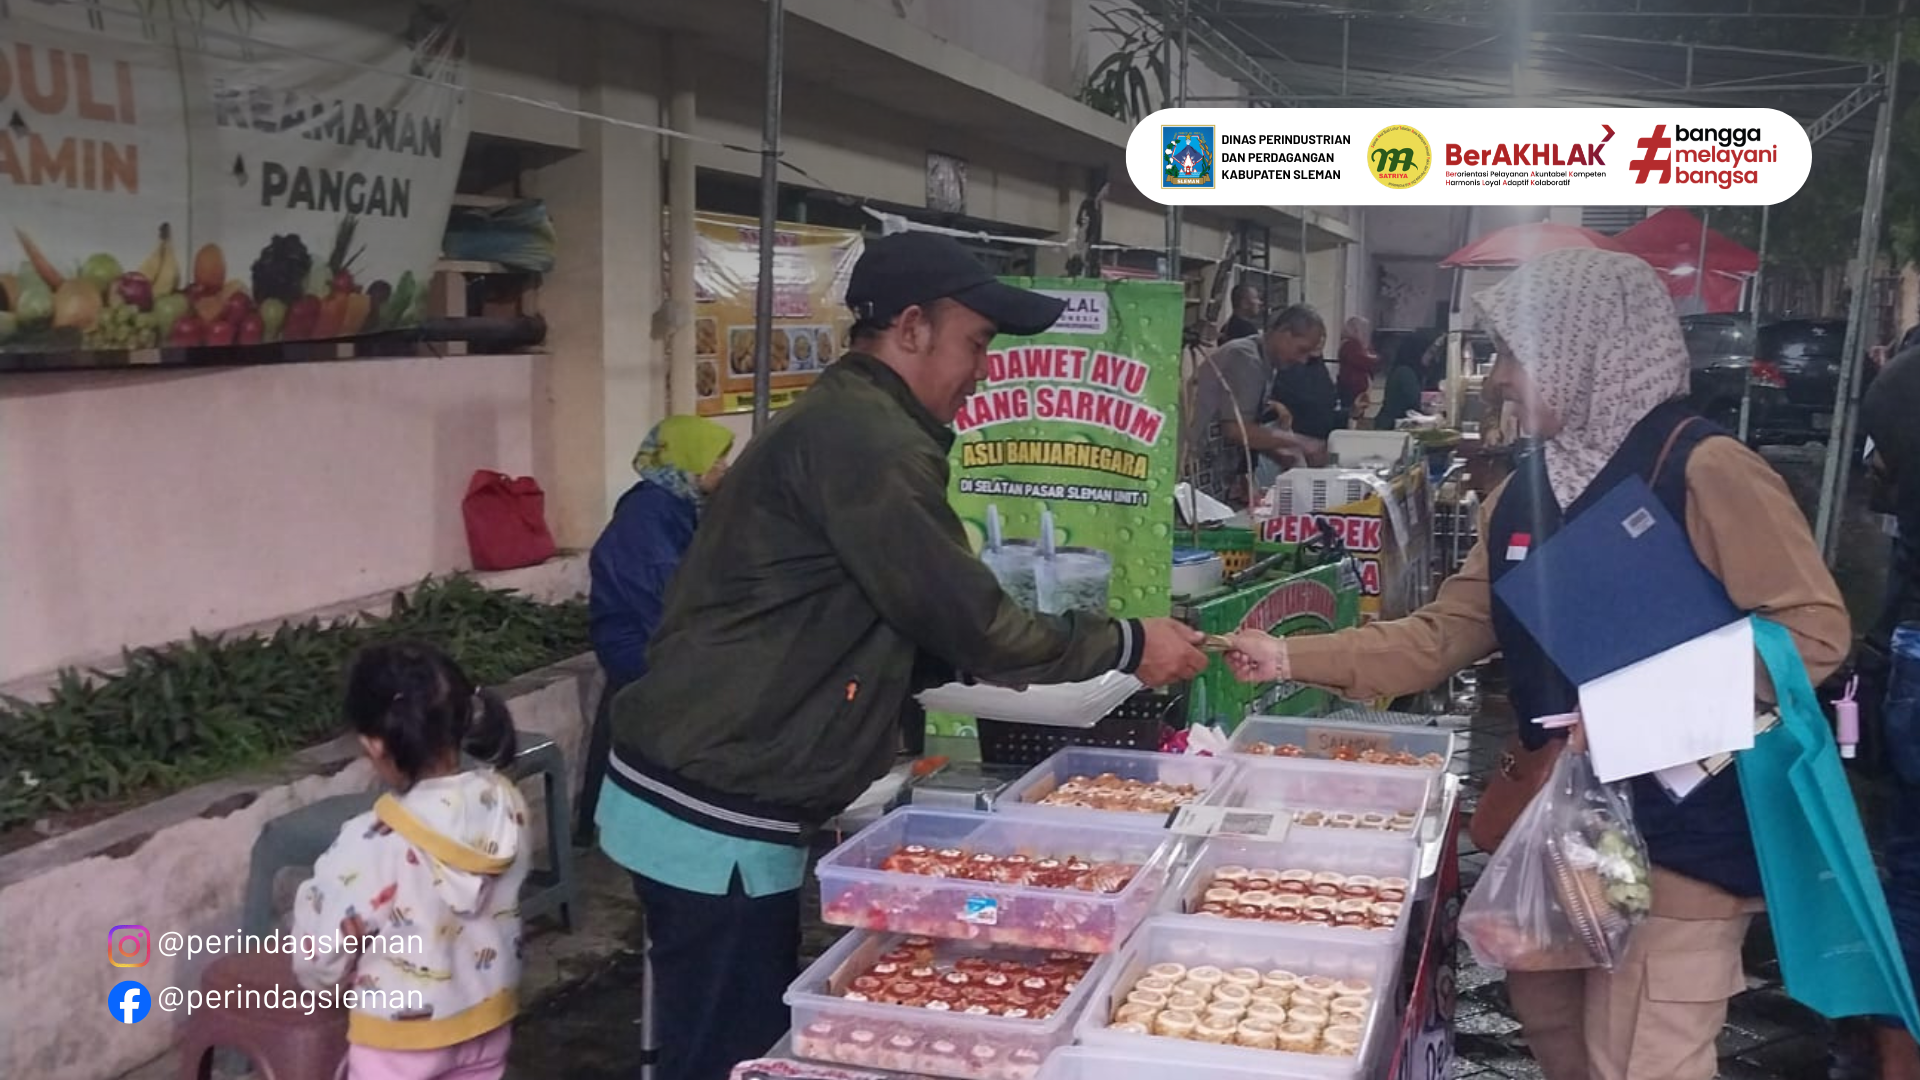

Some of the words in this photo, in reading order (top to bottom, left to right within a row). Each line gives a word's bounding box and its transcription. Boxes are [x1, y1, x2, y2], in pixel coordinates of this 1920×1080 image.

[261, 161, 410, 218] PANGAN
[987, 348, 1087, 382] DAWET
[1090, 353, 1148, 394] AYU
[954, 388, 1029, 431] KANG
[1036, 387, 1163, 443] SARKUM
[962, 441, 1004, 468] ASLI
[1006, 440, 1149, 480] BANJARNEGARA
[960, 480, 973, 492] DI
[974, 481, 1023, 496] SELATAN
[1024, 484, 1065, 499] PASAR
[1067, 486, 1112, 502] SLEMAN
